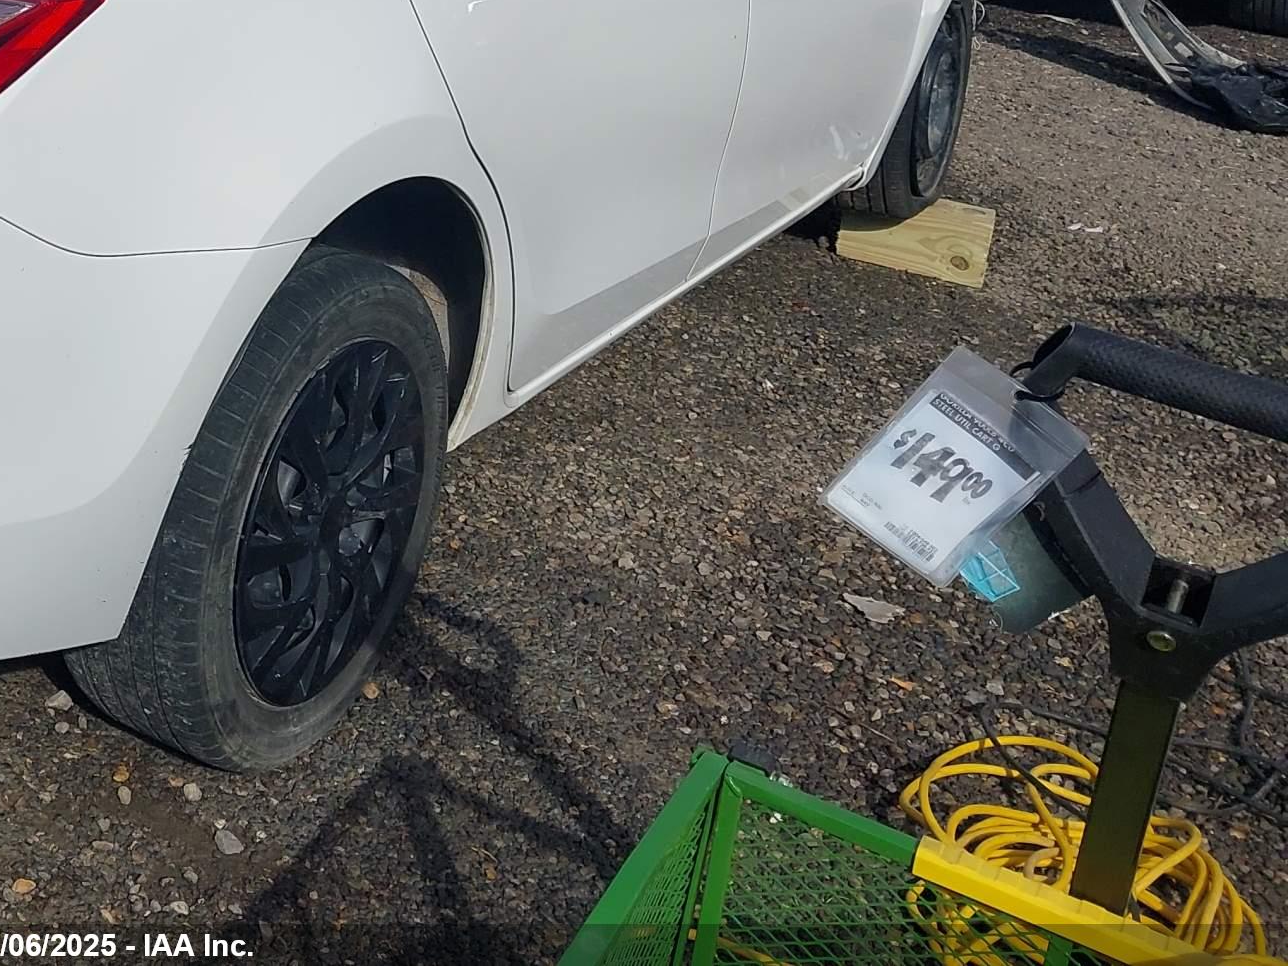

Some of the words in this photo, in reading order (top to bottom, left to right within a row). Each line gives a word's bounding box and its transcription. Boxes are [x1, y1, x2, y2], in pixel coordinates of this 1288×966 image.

[932, 398, 955, 416] STEEL
[954, 414, 972, 430] UTIL
[972, 427, 994, 444] CART
